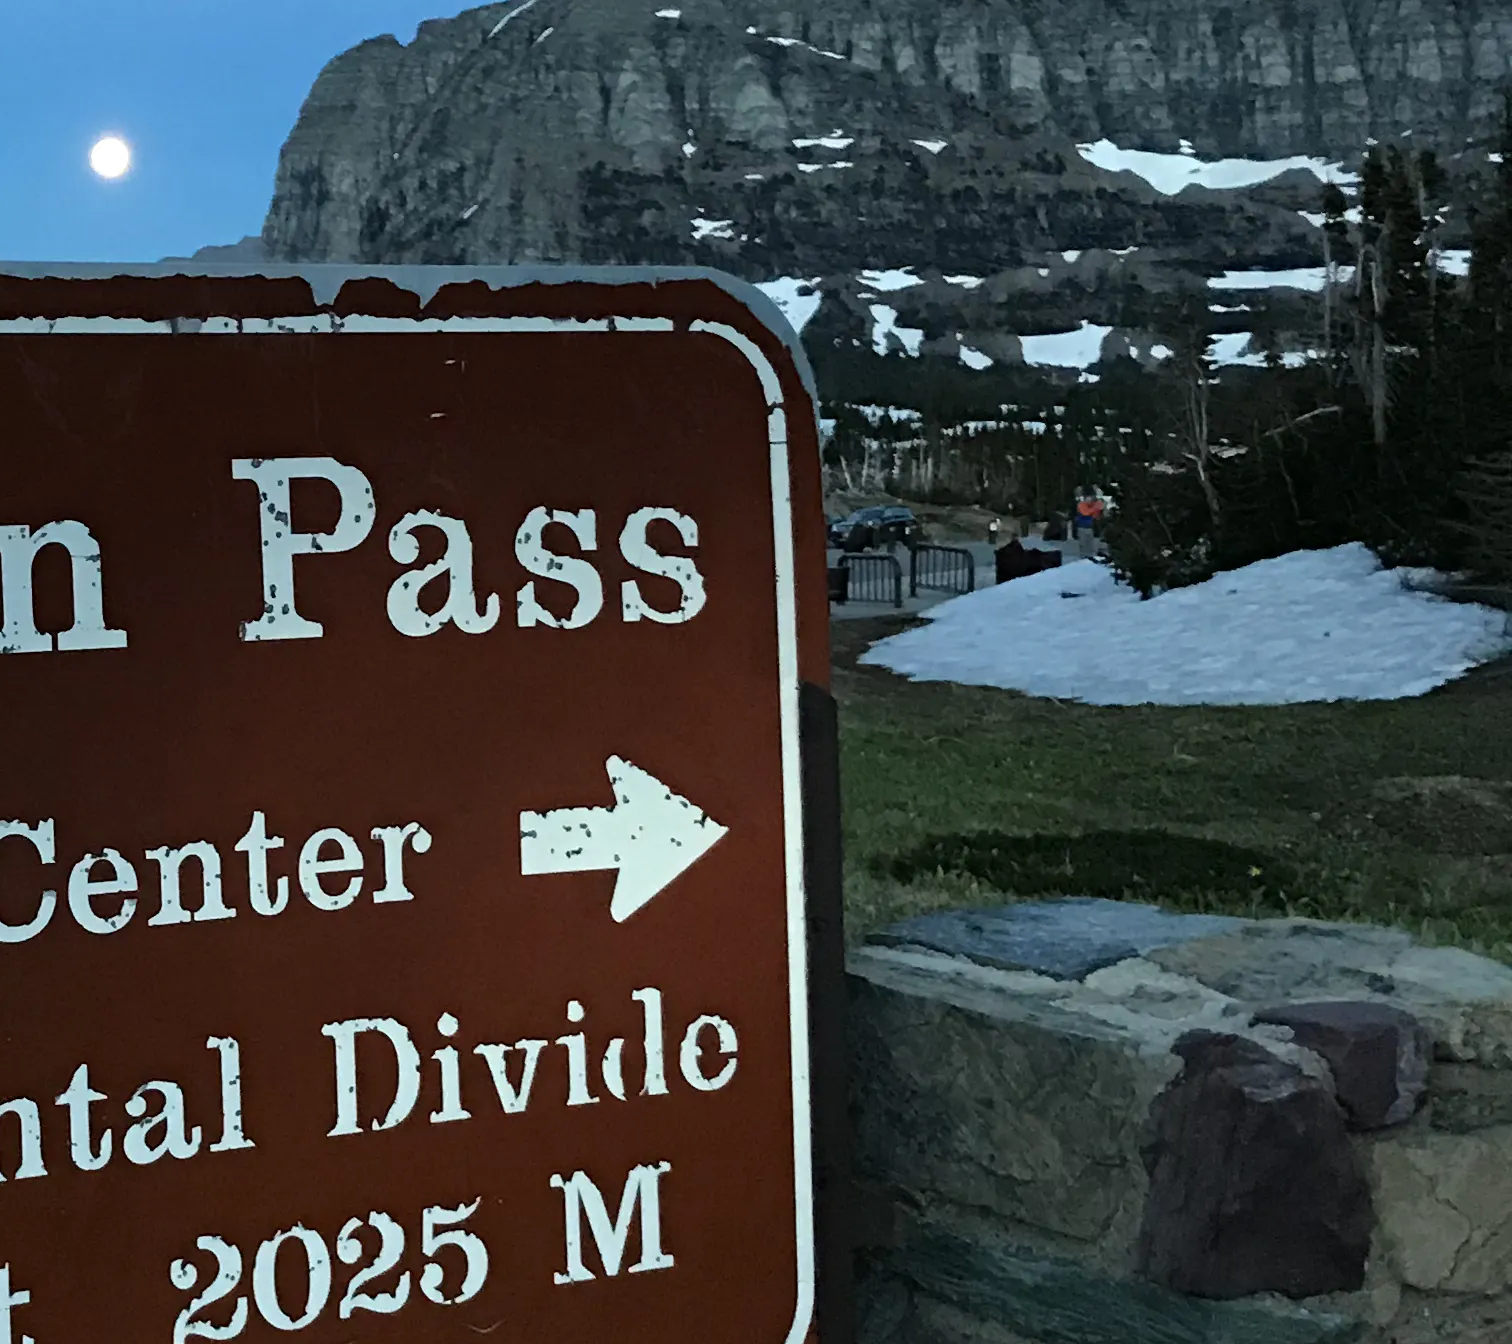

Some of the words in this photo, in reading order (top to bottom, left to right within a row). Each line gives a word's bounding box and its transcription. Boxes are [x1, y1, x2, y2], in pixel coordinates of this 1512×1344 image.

[232, 457, 707, 642] Pass
[321, 987, 739, 1137] Divide
[550, 1161, 674, 1284] M
